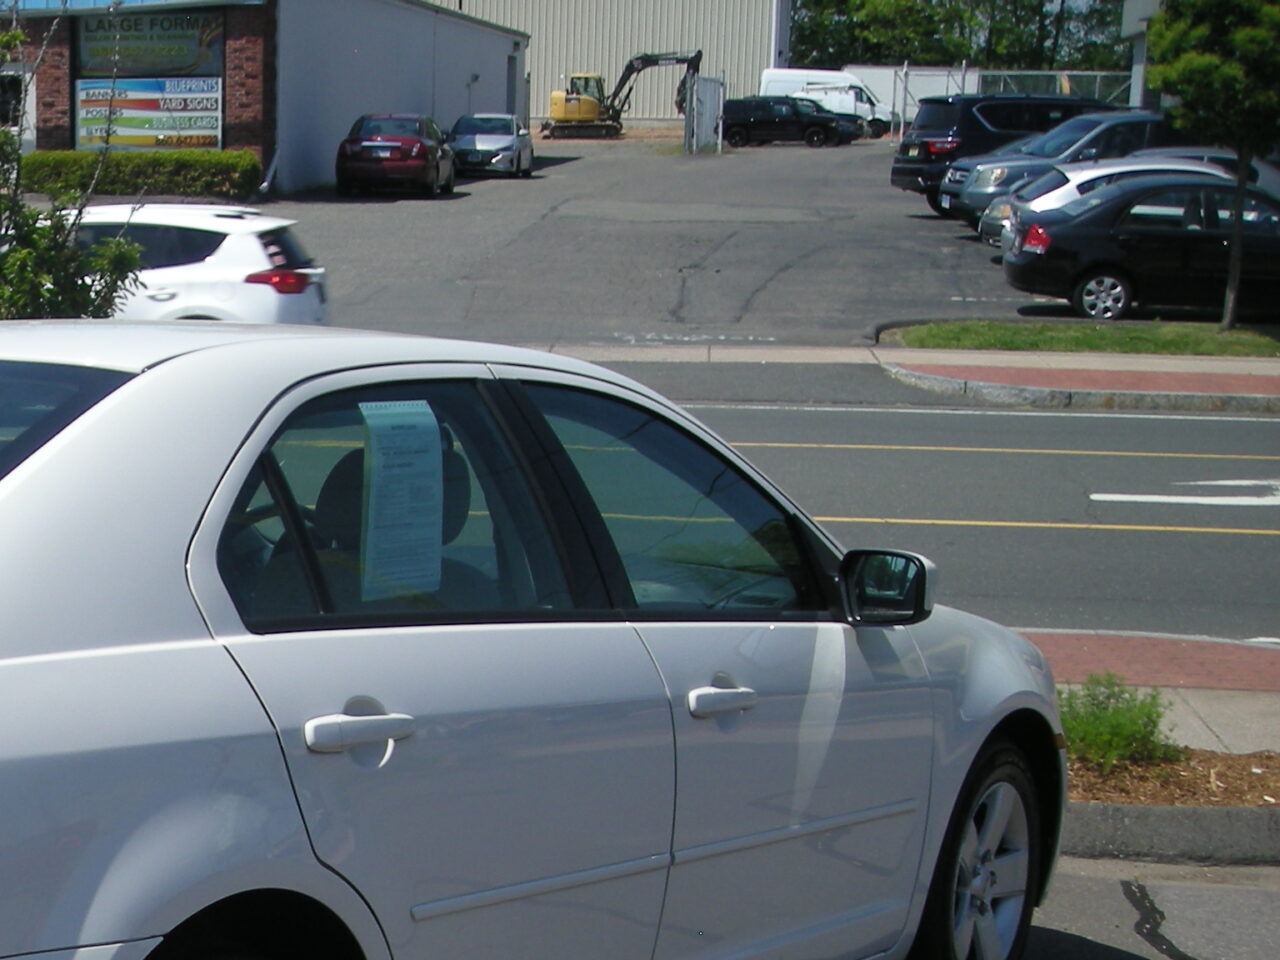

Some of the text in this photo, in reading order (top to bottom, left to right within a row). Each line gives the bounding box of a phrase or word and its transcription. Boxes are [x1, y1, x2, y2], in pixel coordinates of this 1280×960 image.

[165, 79, 218, 92] BLUEPRINTS
[160, 97, 217, 110] YARD SIGNS
[86, 109, 124, 118] POSTRS
[191, 116, 218, 129] CARDS
